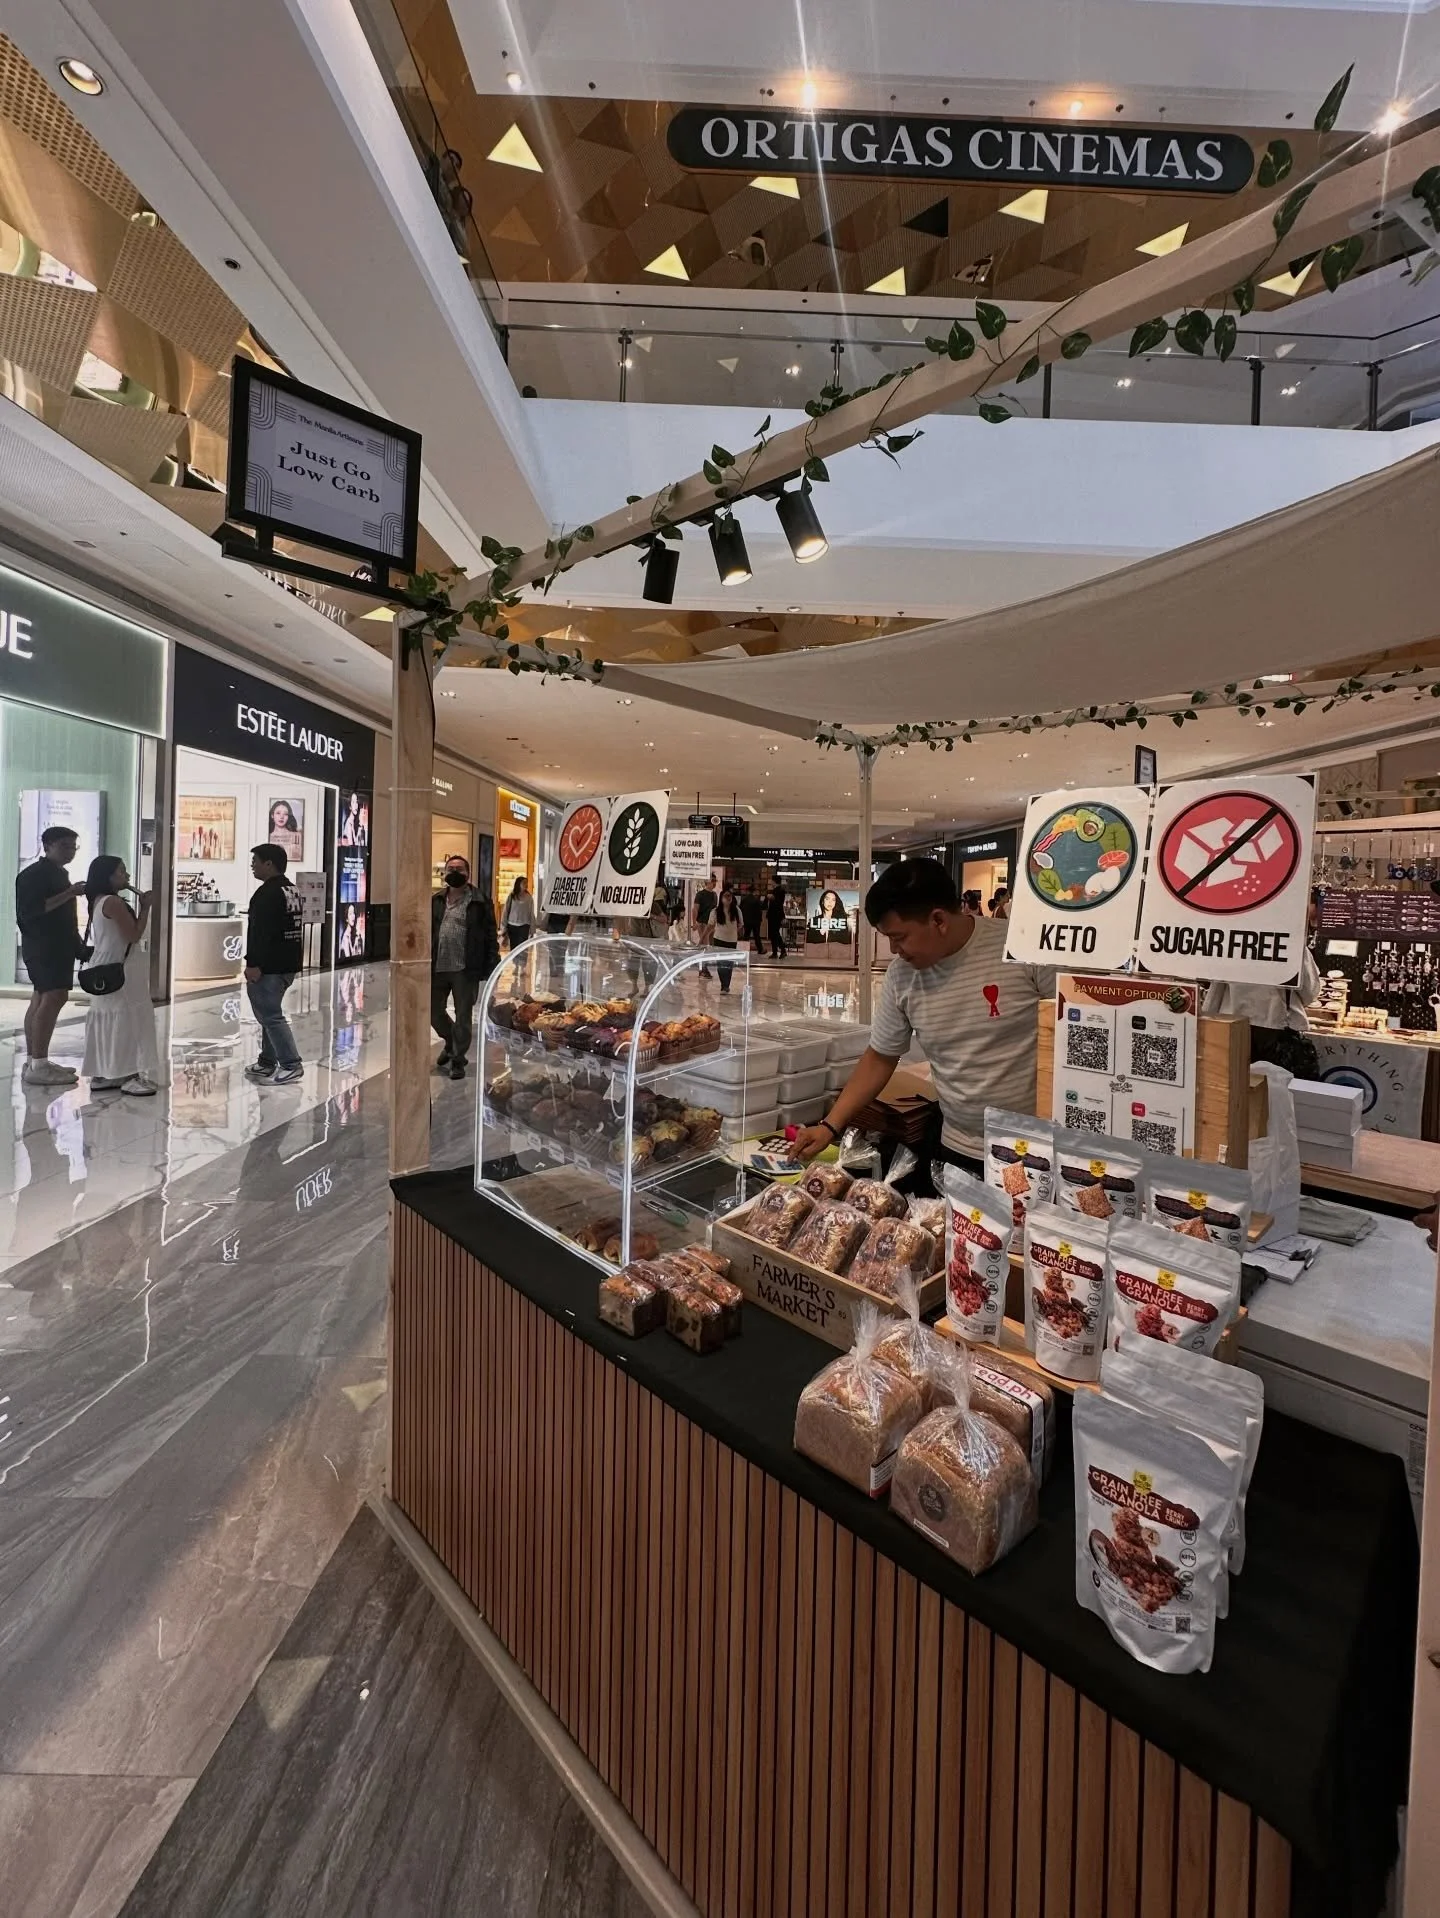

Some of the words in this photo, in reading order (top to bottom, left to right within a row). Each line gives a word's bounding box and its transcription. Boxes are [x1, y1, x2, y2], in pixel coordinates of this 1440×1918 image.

[700, 116, 953, 168] ORTIGAS
[968, 127, 1225, 182] CINEMAS
[290, 441, 338, 469] Just
[343, 461, 371, 481] Go
[277, 454, 324, 482] Low
[331, 475, 380, 503] Carb
[290, 723, 343, 762] LAUDER
[672, 851, 691, 859] GLUTEN
[692, 852, 705, 860] FREE
[687, 840, 703, 848] CARB
[780, 849, 814, 858] KIEHL'S
[553, 876, 588, 892] DIABETIC
[599, 885, 613, 903] NO
[613, 886, 647, 905] GLUTEN
[549, 891, 586, 906] FRIENDLY
[810, 917, 847, 930] LIBRE
[1039, 923, 1097, 954] KETO
[1150, 925, 1225, 958] SUGAR
[1227, 929, 1290, 963] FREE
[1073, 983, 1122, 997] PAYMENT
[1124, 988, 1173, 1002] OPTIONS
[967, 1221, 983, 1236] FREE
[1033, 1245, 1056, 1259] GRAIN
[1058, 1254, 1078, 1267] FREE
[1038, 1254, 1077, 1273] GRANOLA
[752, 1254, 836, 1310] FARMER'S
[1119, 1274, 1153, 1294] GRAIN
[1156, 1287, 1184, 1305] FREE
[757, 1279, 830, 1329] MARKET
[1126, 1286, 1182, 1314] GRANOLA
[976, 1366, 1032, 1401] ead.ph
[1092, 1471, 1129, 1496] GRAIN
[1133, 1489, 1163, 1510] FREE
[1101, 1486, 1160, 1520] GRANOLA
[1164, 1515, 1189, 1527] CRUNCH
[1165, 1508, 1185, 1520] BERRY
